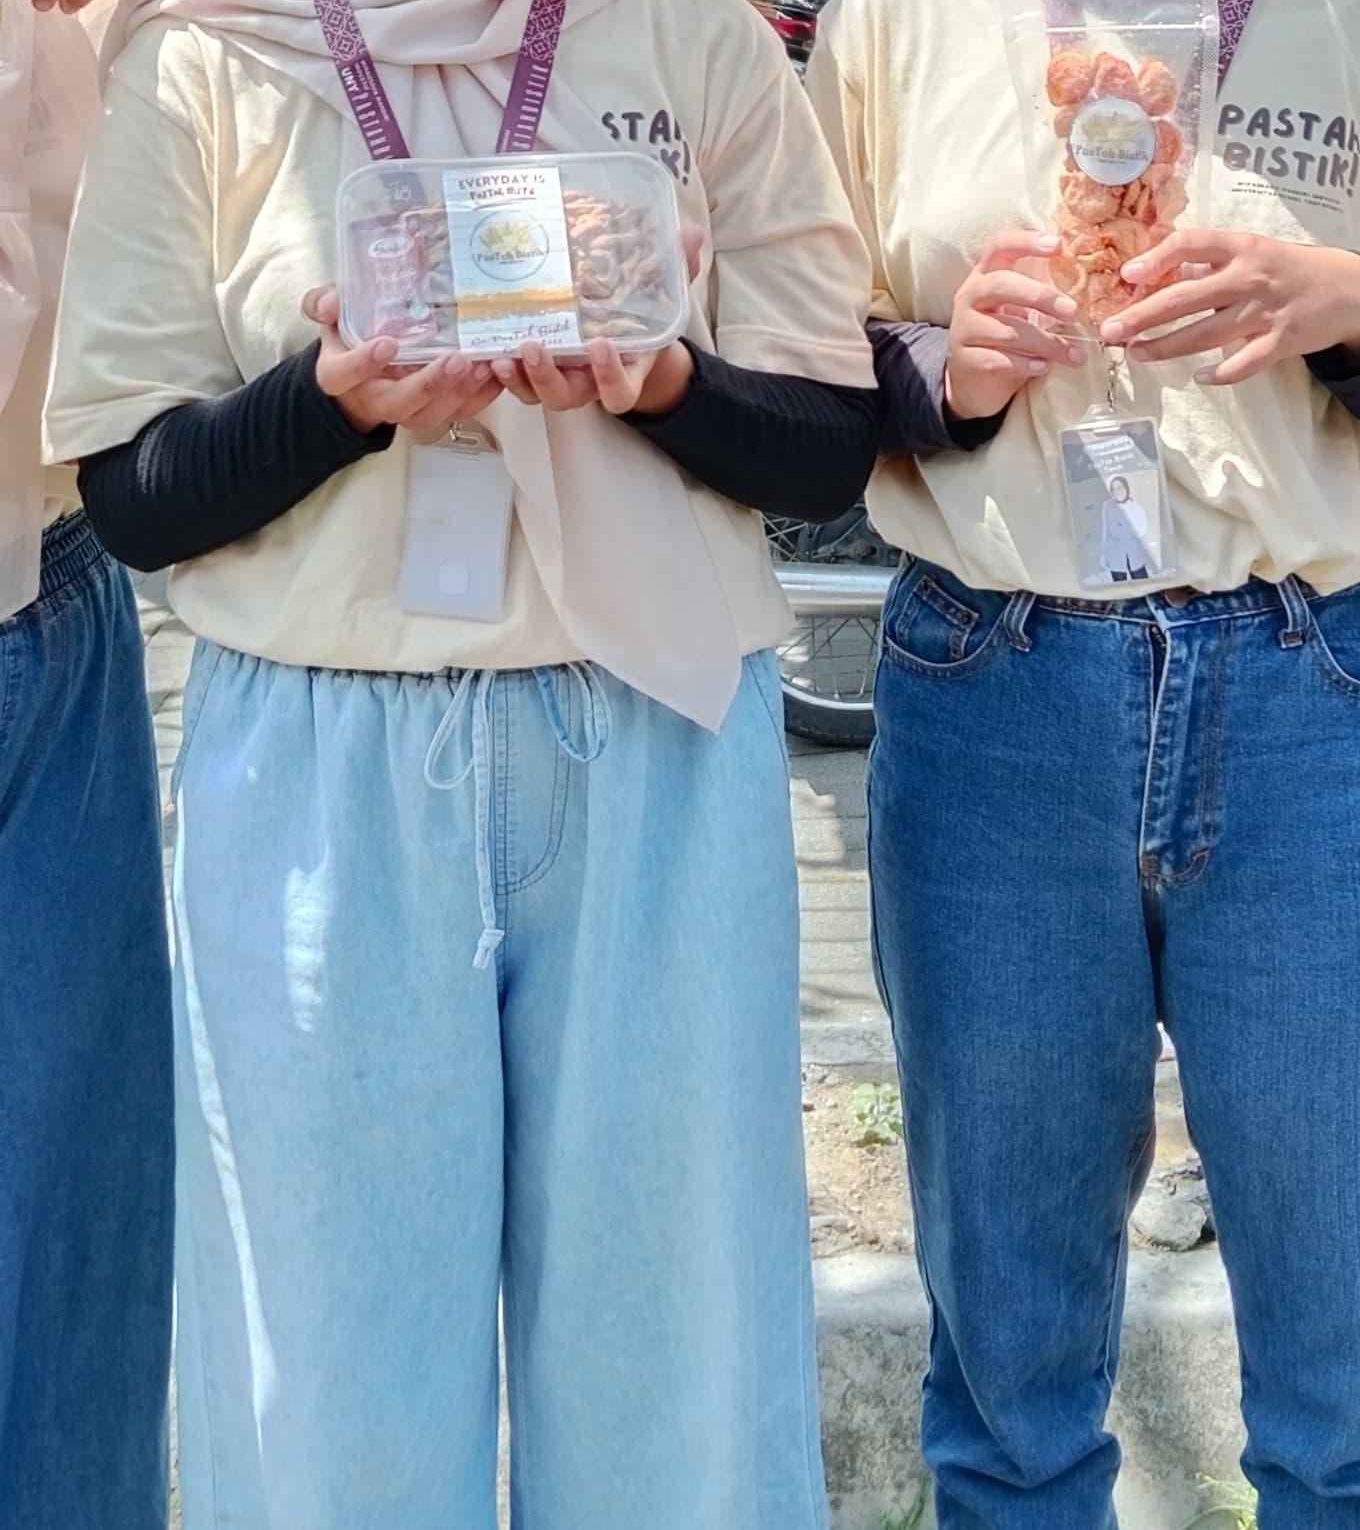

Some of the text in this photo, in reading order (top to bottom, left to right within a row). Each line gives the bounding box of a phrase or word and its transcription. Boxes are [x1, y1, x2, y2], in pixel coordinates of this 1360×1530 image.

[341, 66, 360, 92] UNY
[602, 110, 682, 144] STA
[459, 174, 529, 190] EVERYDAY
[1223, 141, 1360, 198] BISTIK!
